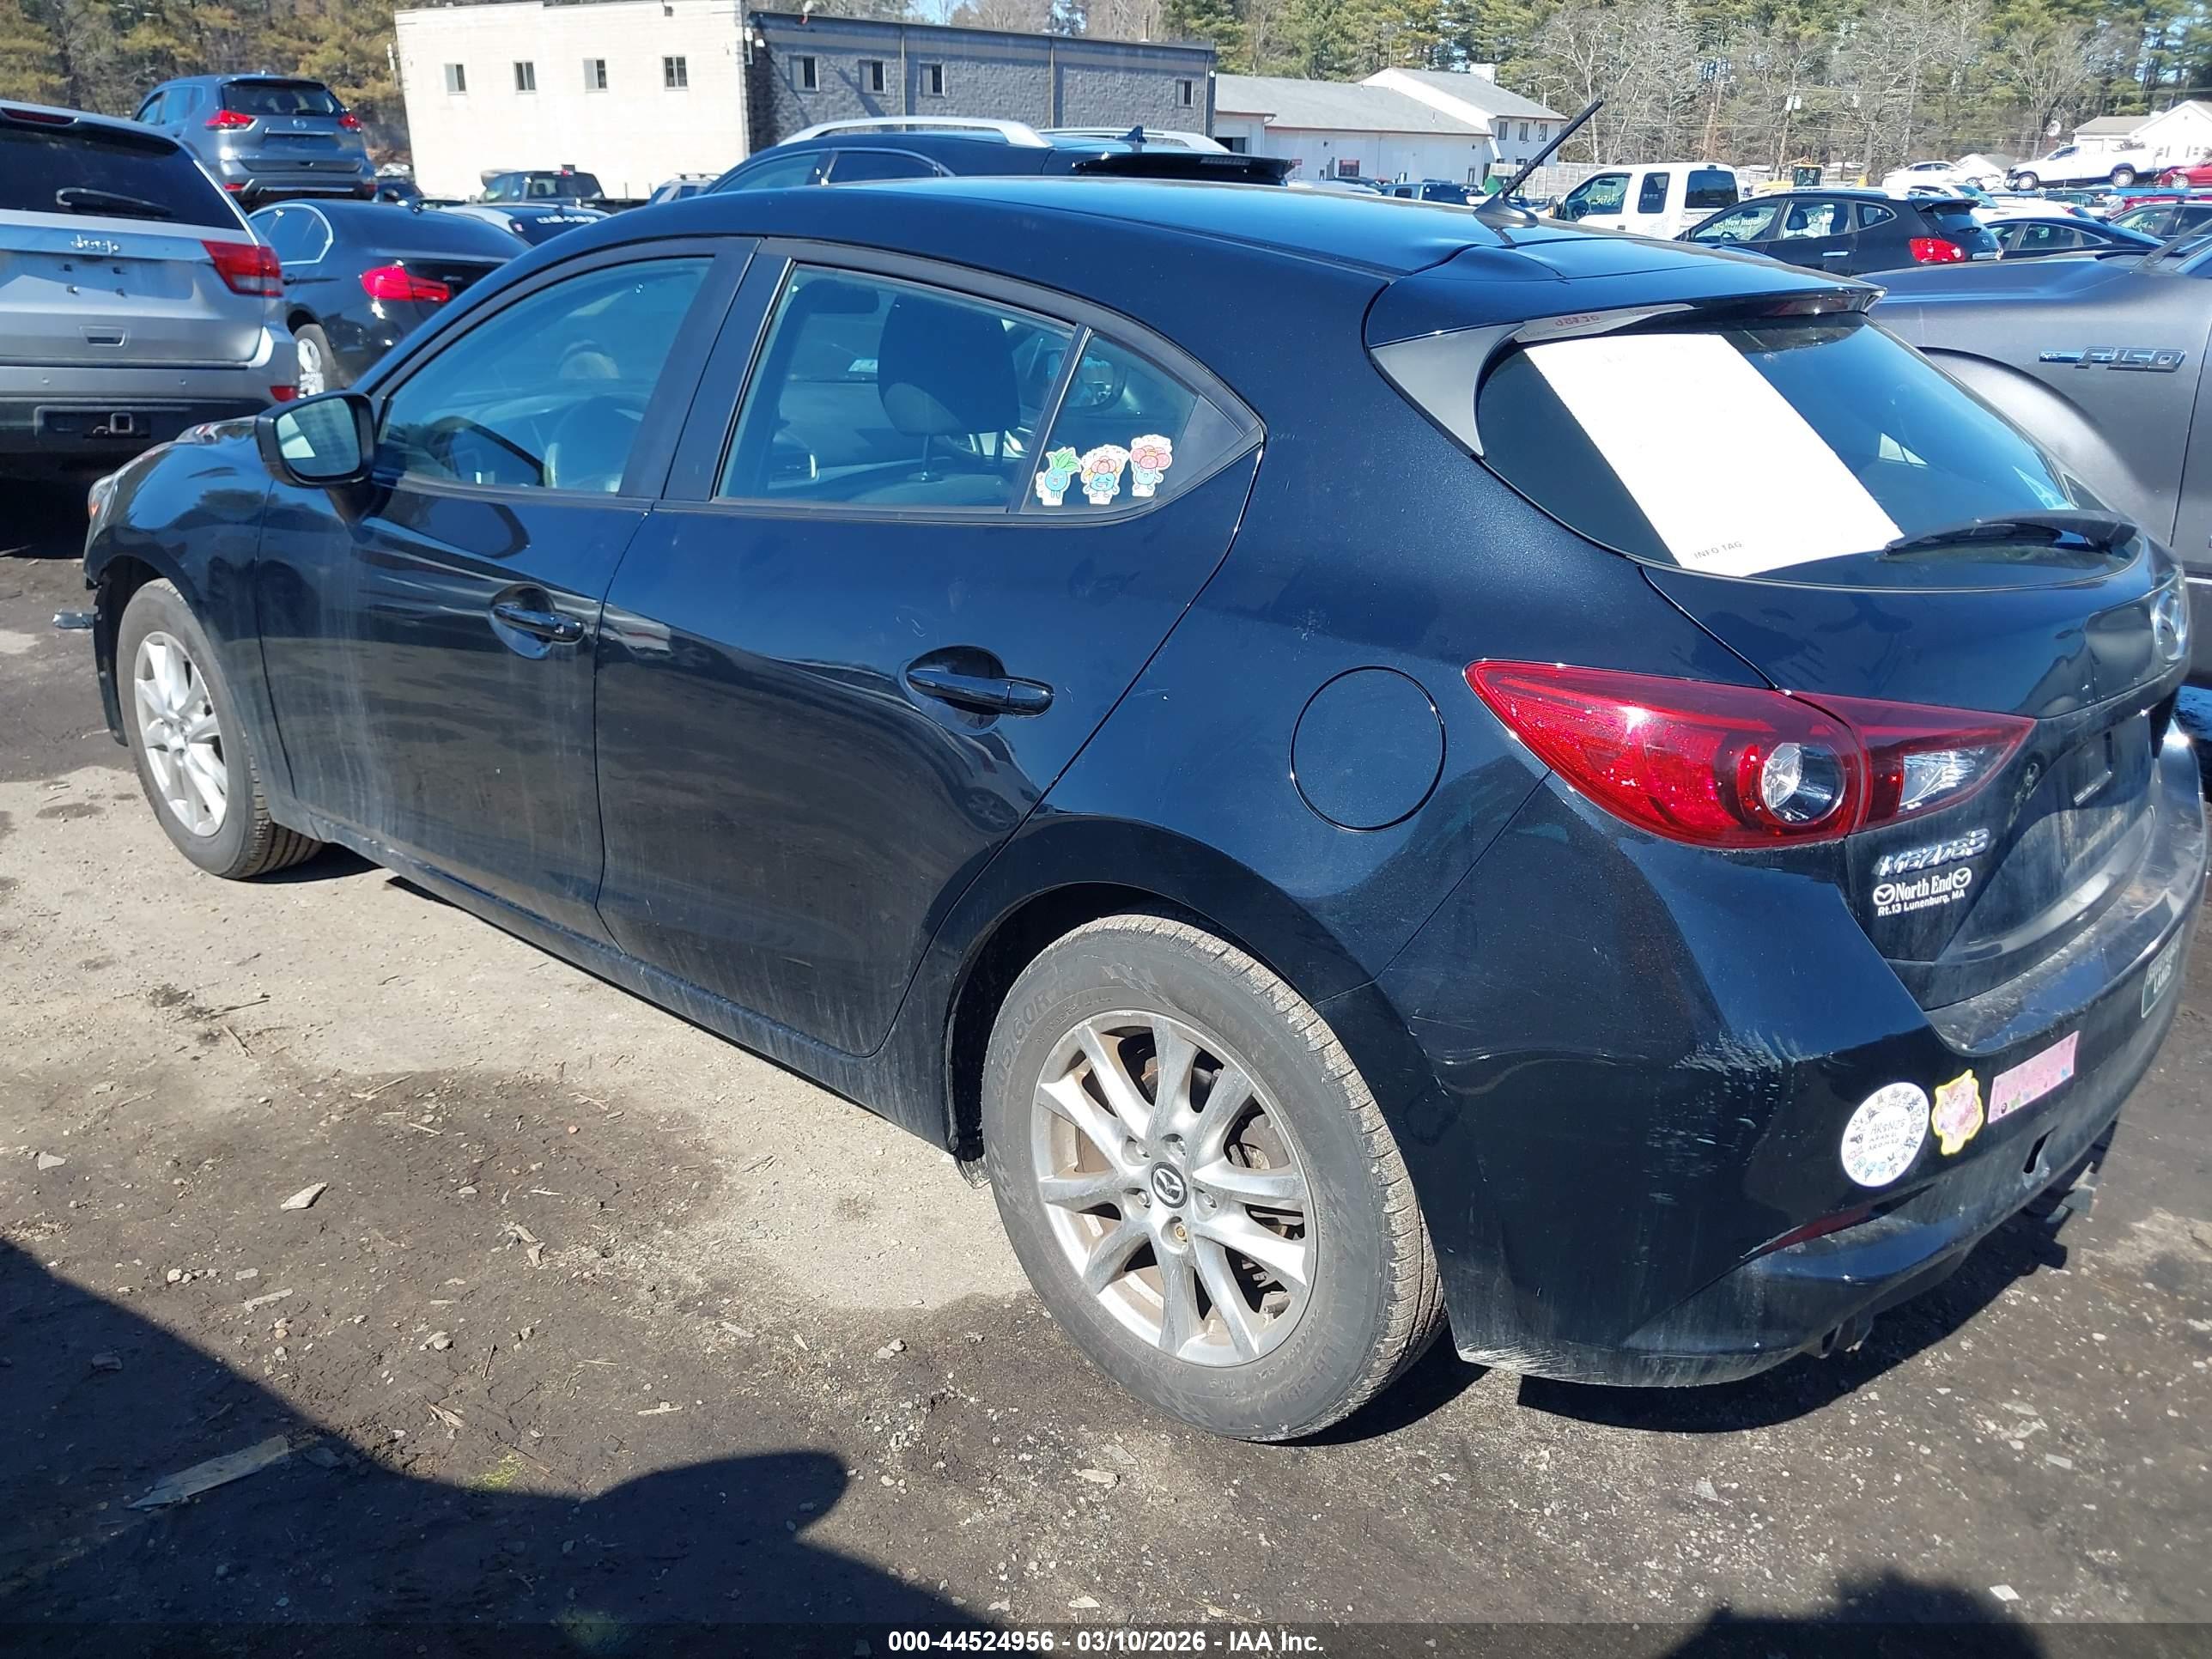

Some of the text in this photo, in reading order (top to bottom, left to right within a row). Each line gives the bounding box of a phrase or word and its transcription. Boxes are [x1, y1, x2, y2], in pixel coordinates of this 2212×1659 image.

[2075, 346, 2186, 373] F-150
[1694, 541, 1742, 559] INFO TAG
[1895, 872, 1953, 902] North End
[1878, 889, 1966, 917] Rt.13 Lunenburg, MA
